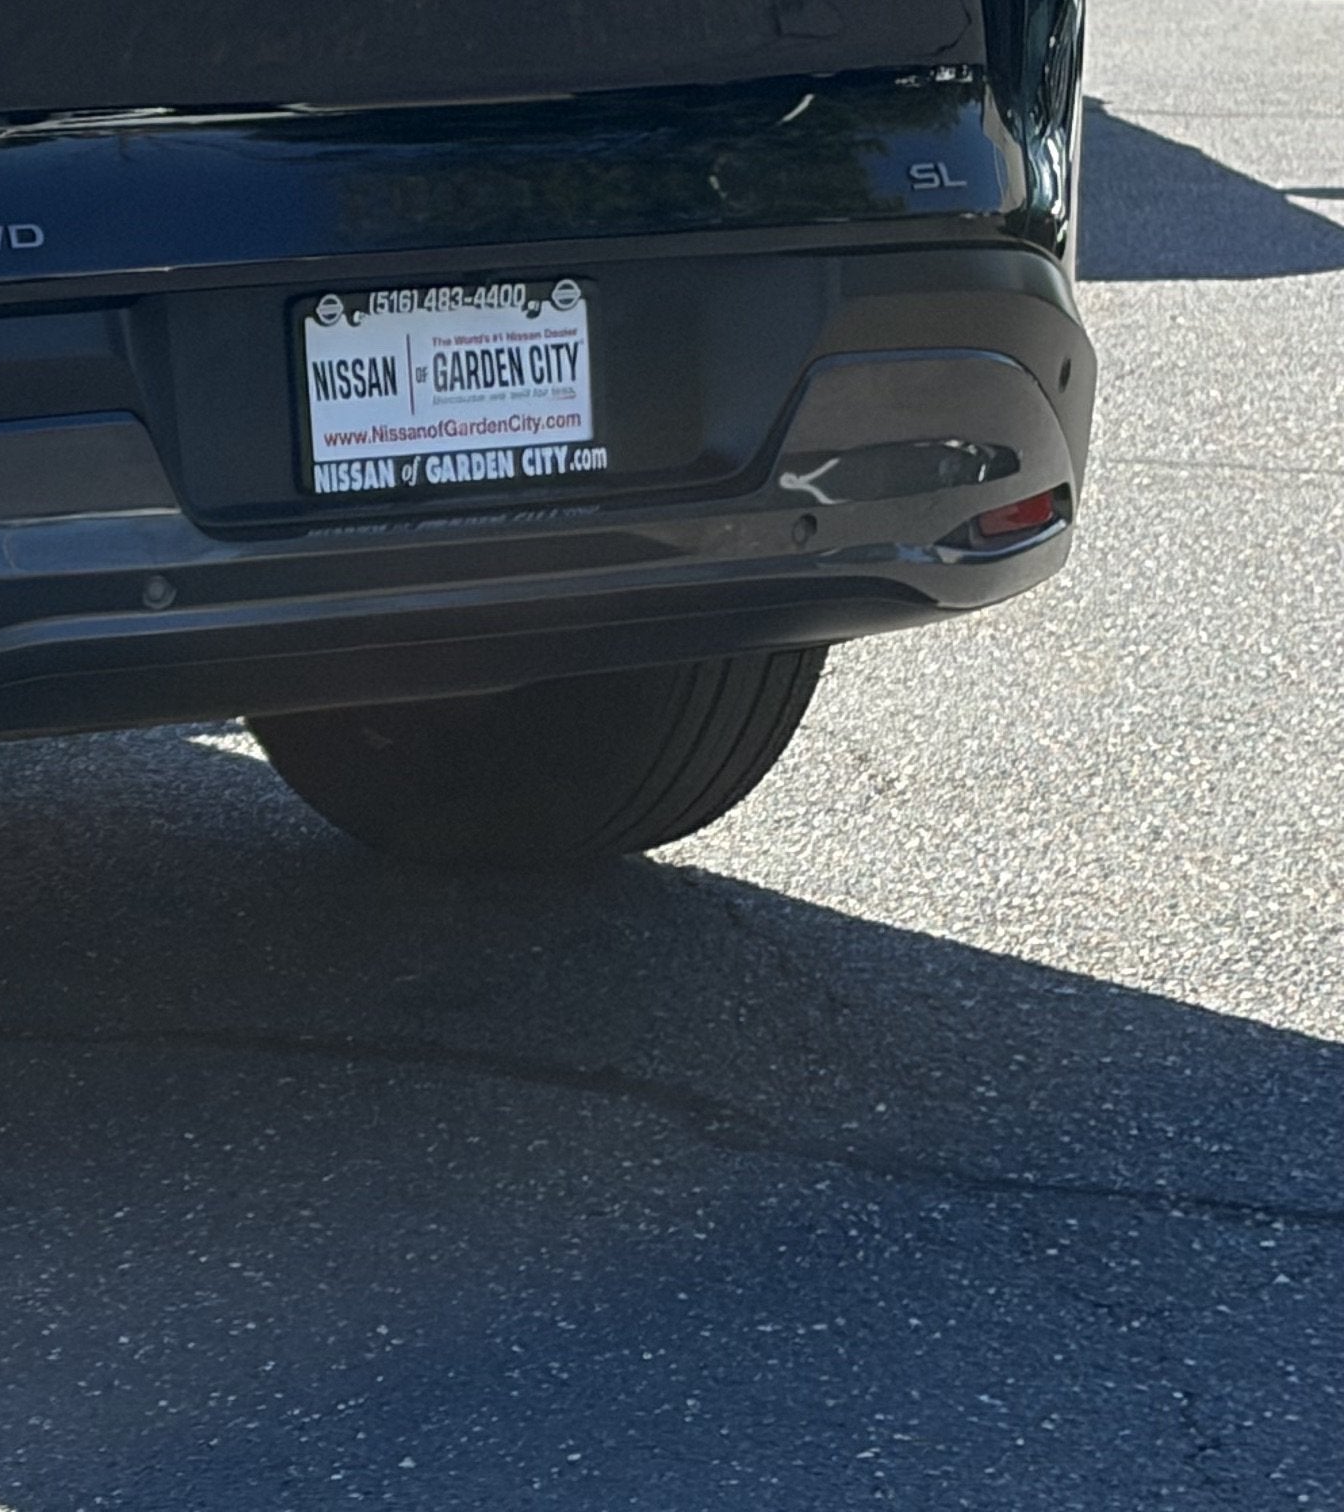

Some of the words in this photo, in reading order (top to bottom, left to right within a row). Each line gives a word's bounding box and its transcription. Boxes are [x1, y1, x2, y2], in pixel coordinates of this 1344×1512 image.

[909, 161, 968, 191] SL
[368, 289, 418, 315] (516)
[422, 284, 526, 313] 483-4400
[432, 336, 452, 347] The
[454, 334, 490, 346] World's
[506, 330, 542, 342] Nissan
[544, 328, 578, 338] Dealer
[312, 356, 398, 402] NISSAN
[415, 366, 429, 384] OF
[433, 346, 525, 393] GARDEN
[529, 341, 579, 386] CITY
[323, 412, 582, 448] www.NissanofGardenCity.com
[313, 459, 396, 494] NISSAN
[401, 454, 422, 487] of
[425, 449, 515, 485] GARDEN
[521, 445, 609, 477] CITY.com
